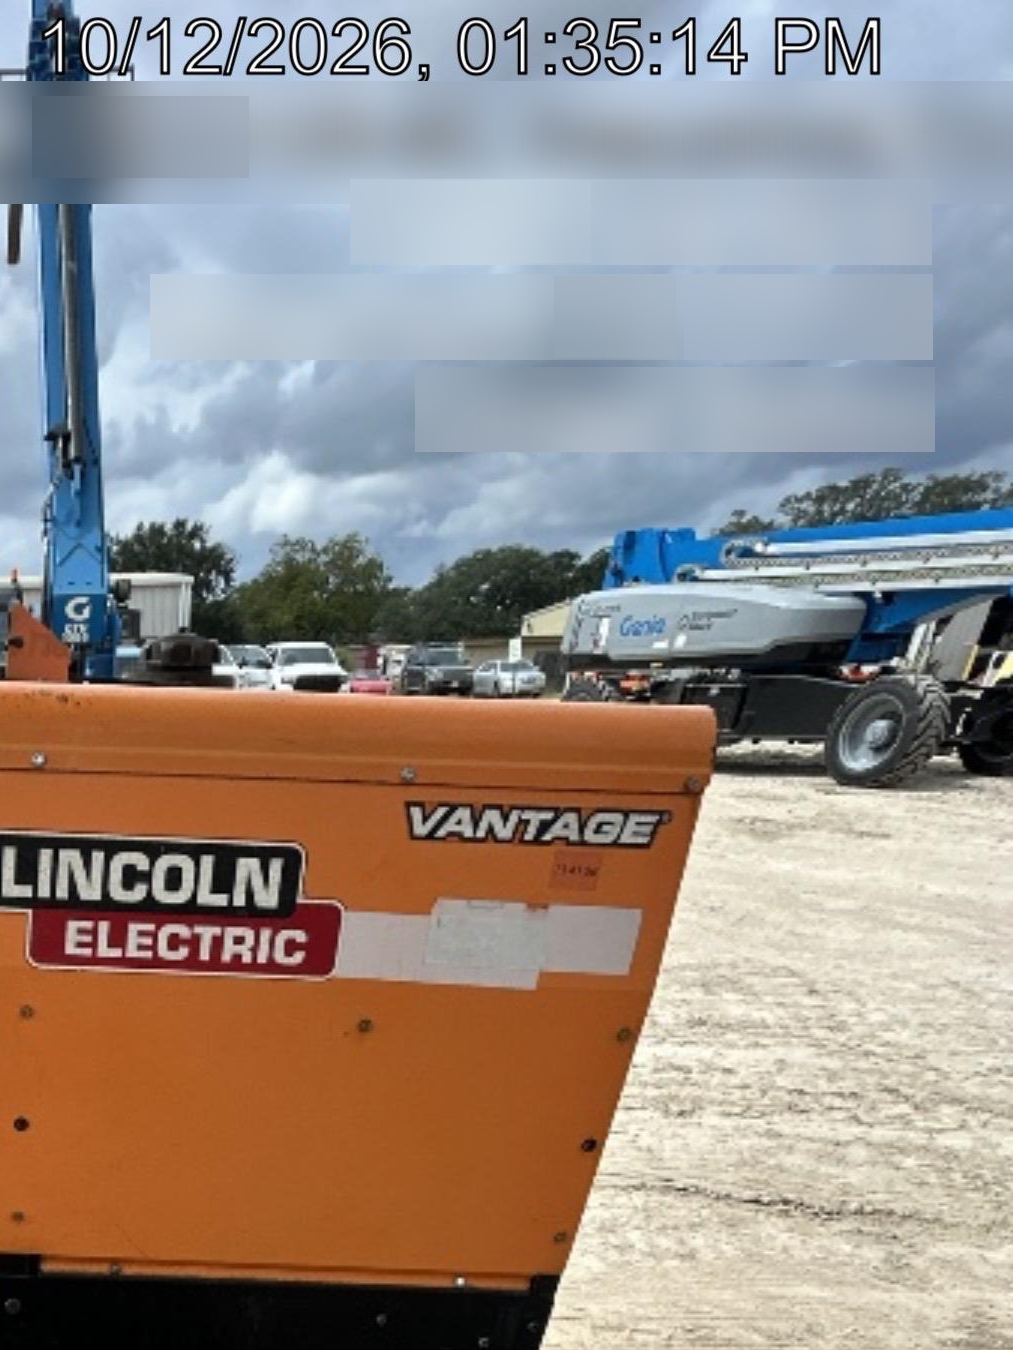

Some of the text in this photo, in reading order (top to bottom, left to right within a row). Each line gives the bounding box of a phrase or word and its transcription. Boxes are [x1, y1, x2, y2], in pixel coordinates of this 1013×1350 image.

[620, 614, 668, 637] Genie
[407, 803, 662, 846] VANTAGE
[0, 845, 284, 909] LINCOLN
[63, 919, 310, 966] ELECTRIC
